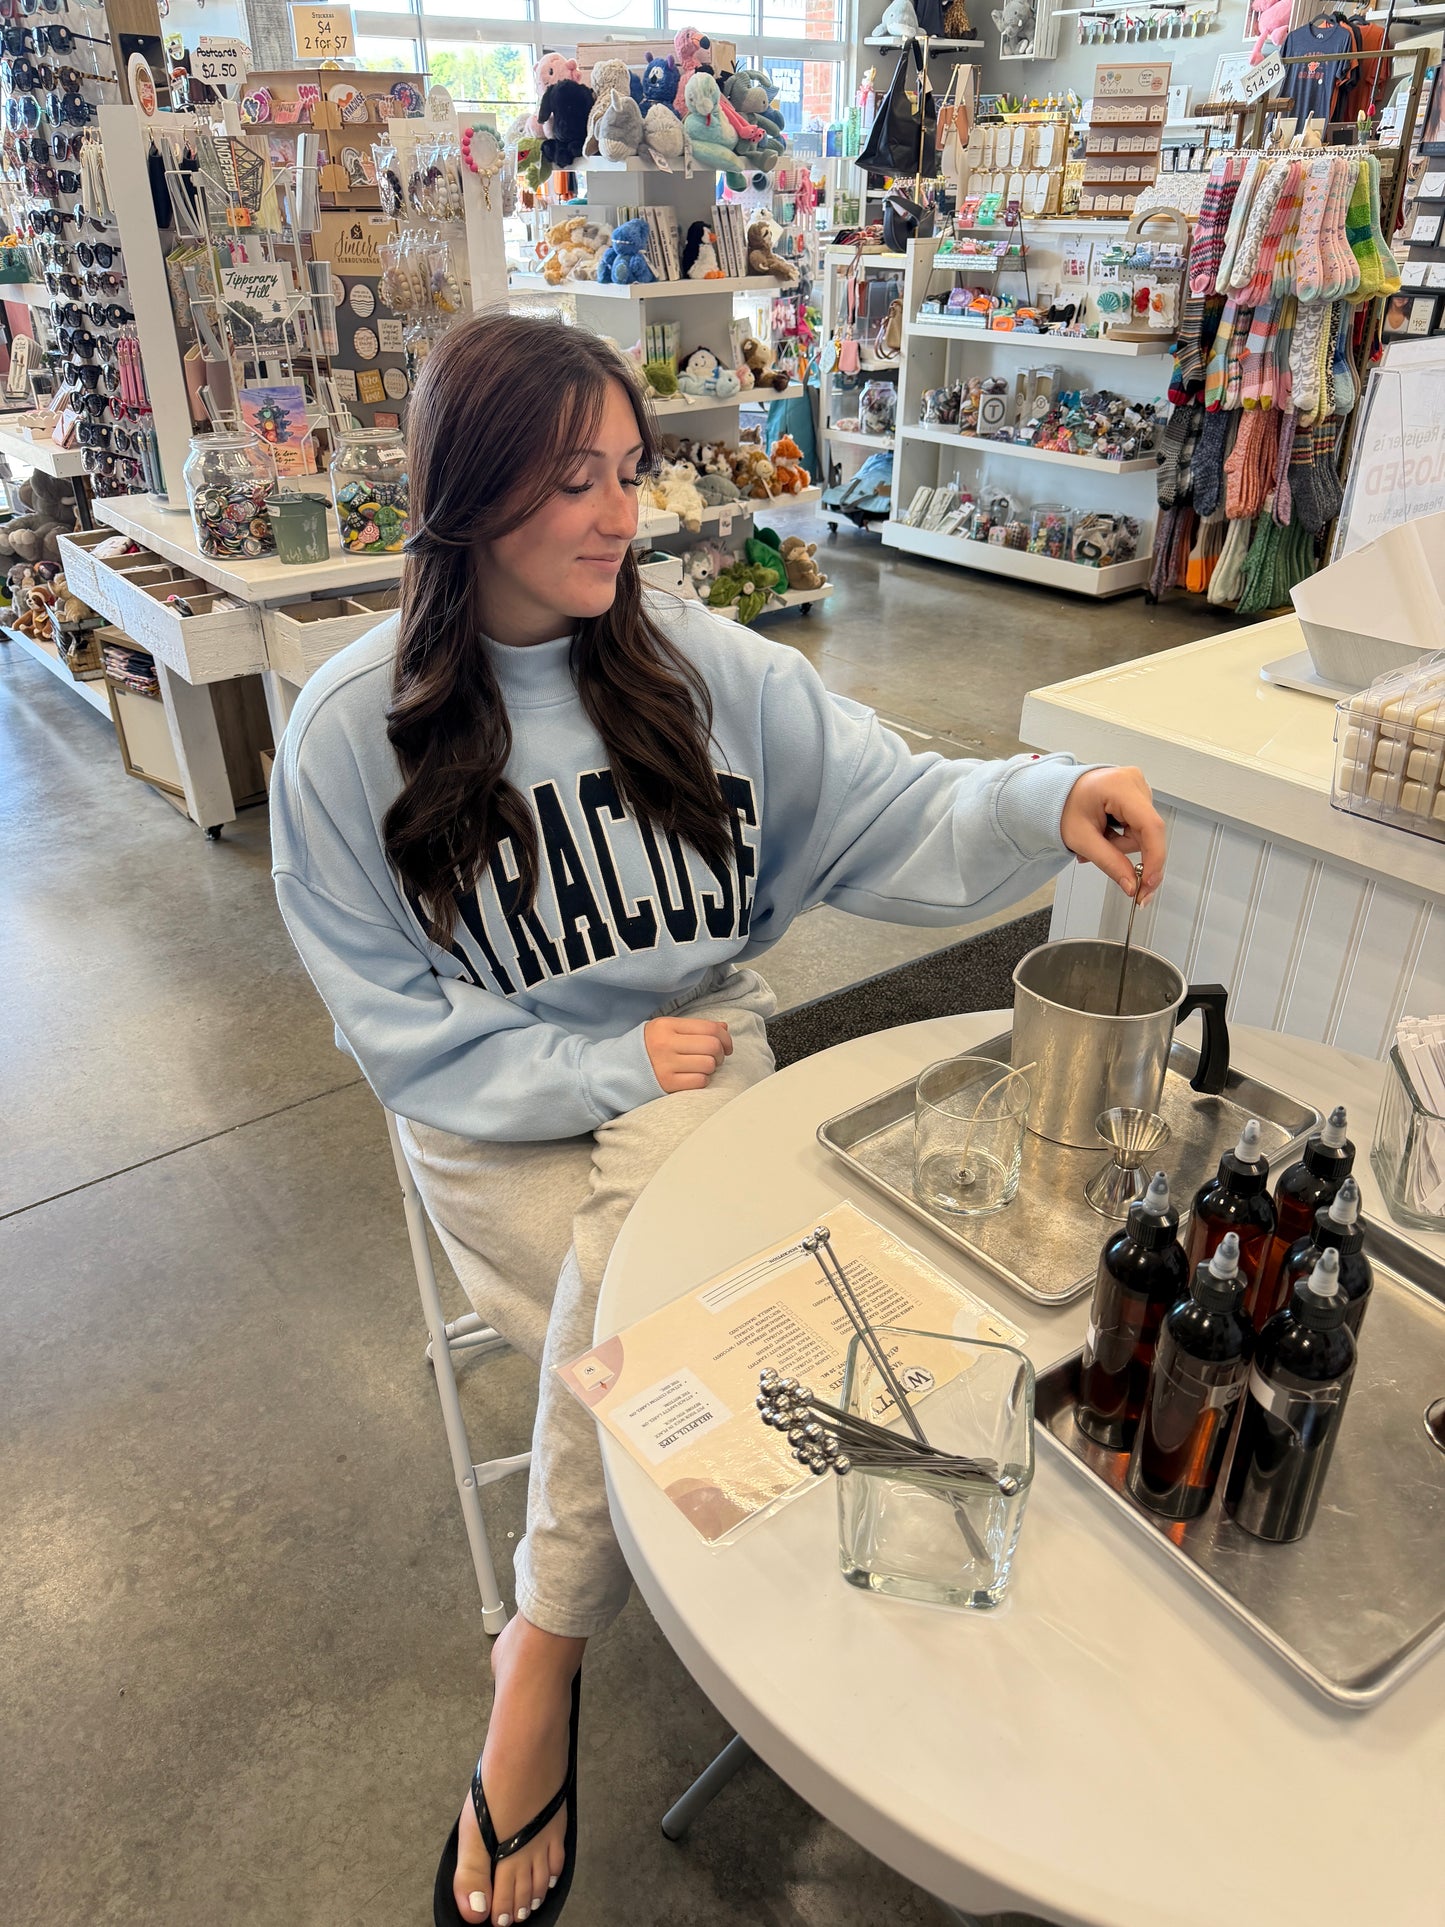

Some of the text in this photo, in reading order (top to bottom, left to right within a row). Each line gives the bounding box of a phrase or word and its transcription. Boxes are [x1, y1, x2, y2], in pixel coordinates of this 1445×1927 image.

[317, 20, 331, 35] $4
[304, 35, 348, 50] 2 for $7
[202, 63, 237, 79] $2.50
[1246, 63, 1280, 97] $14.99
[213, 137, 239, 192] UNDEFEATED
[225, 272, 278, 289] Tipperary
[245, 285, 270, 299] Hill
[658, 1411, 713, 1449] HELPFUL TIPS
